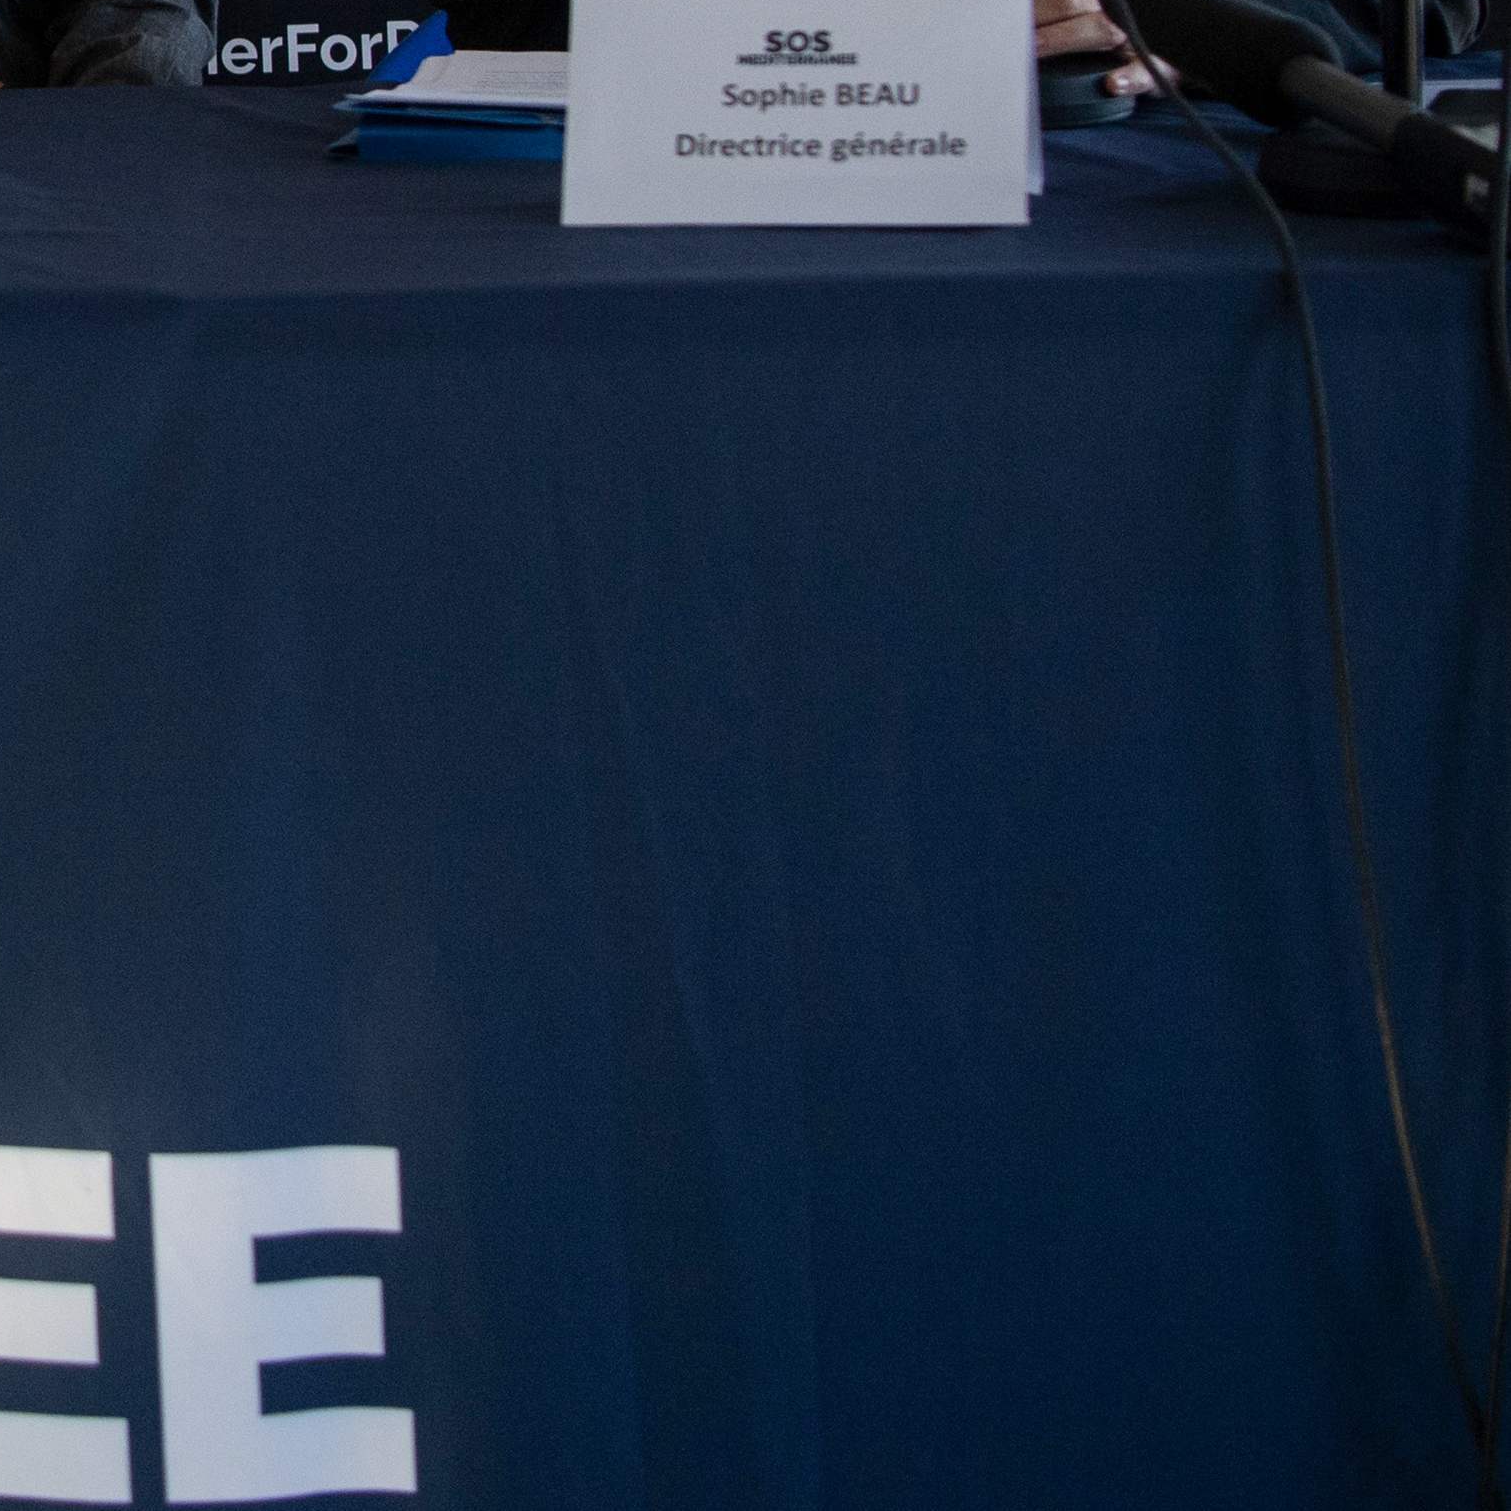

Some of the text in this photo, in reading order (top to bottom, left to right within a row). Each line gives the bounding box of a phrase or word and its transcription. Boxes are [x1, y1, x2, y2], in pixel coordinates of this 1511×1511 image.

[765, 30, 832, 53] SOS
[722, 83, 921, 113] Sophie BEAU
[675, 131, 968, 162] Directrice générale
